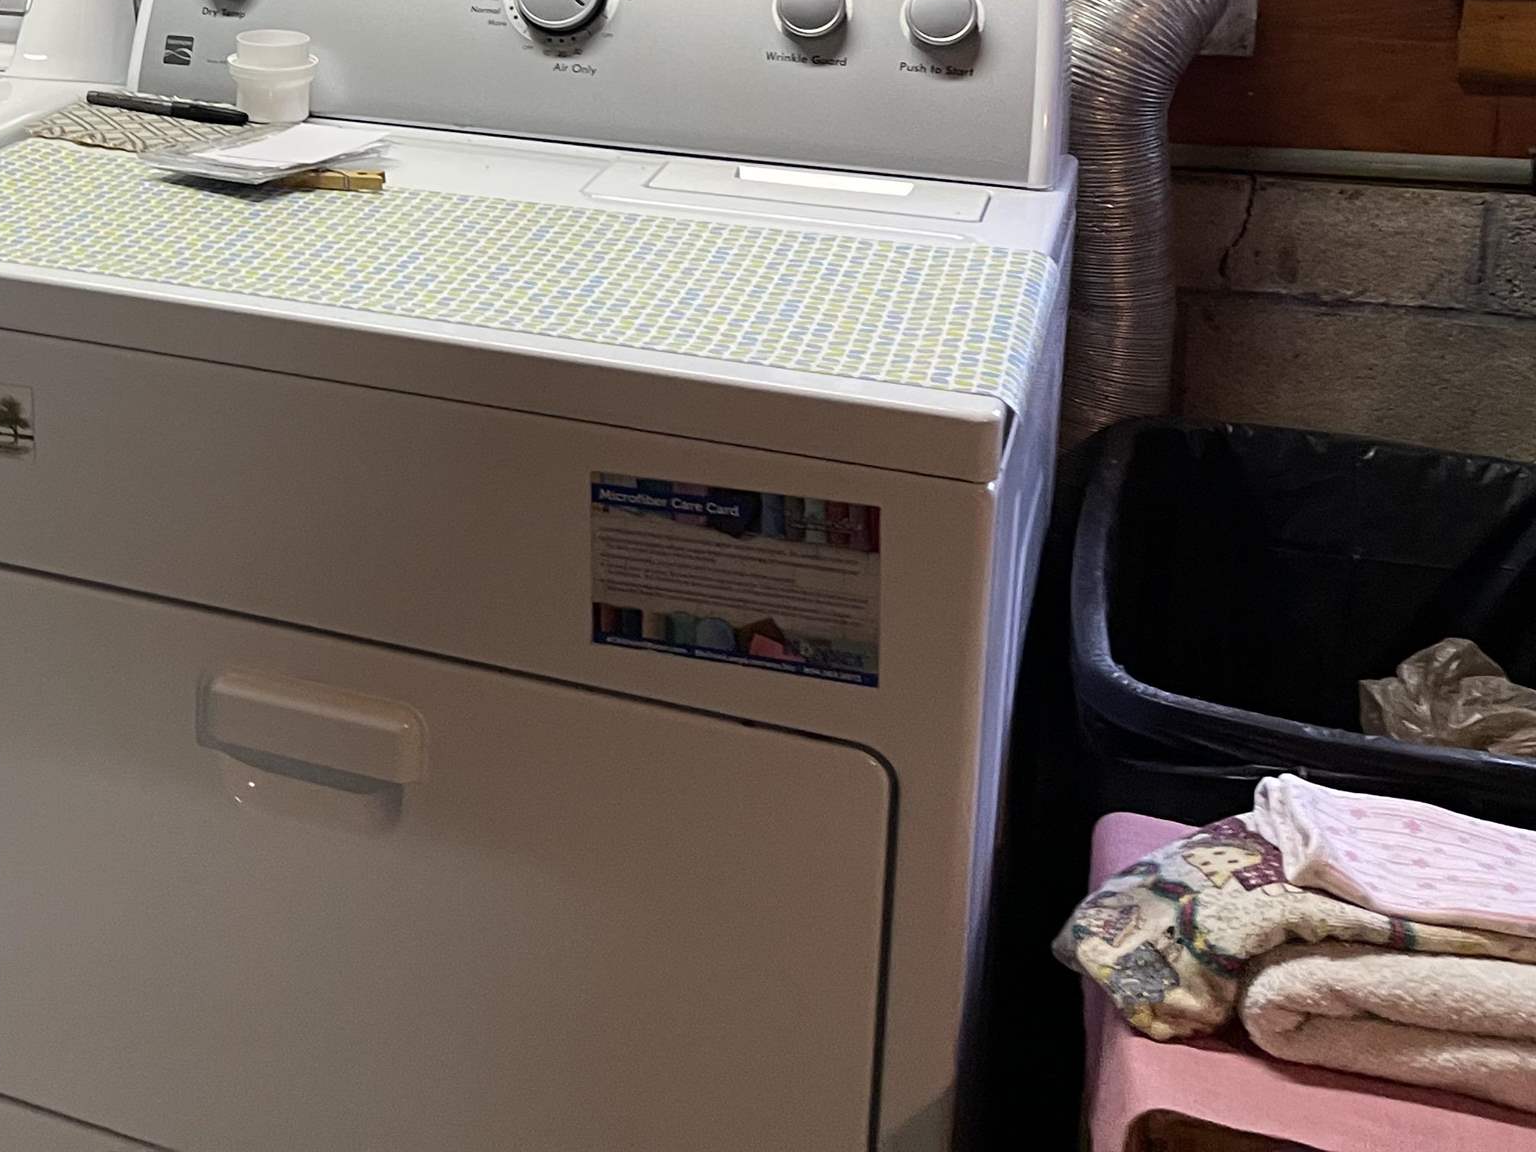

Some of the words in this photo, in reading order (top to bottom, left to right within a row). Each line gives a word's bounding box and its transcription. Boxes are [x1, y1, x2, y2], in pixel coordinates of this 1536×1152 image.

[201, 6, 218, 18] Dry
[470, 6, 501, 15] Normal
[766, 51, 809, 64] Wrinkle
[811, 55, 848, 67] Guard
[553, 63, 569, 72] Air
[571, 64, 597, 77] Only
[900, 62, 927, 74] Push
[930, 65, 942, 75] to
[945, 66, 975, 77] Start
[598, 488, 667, 508] Microfiber
[670, 497, 704, 512] Care
[706, 503, 741, 517] Card
